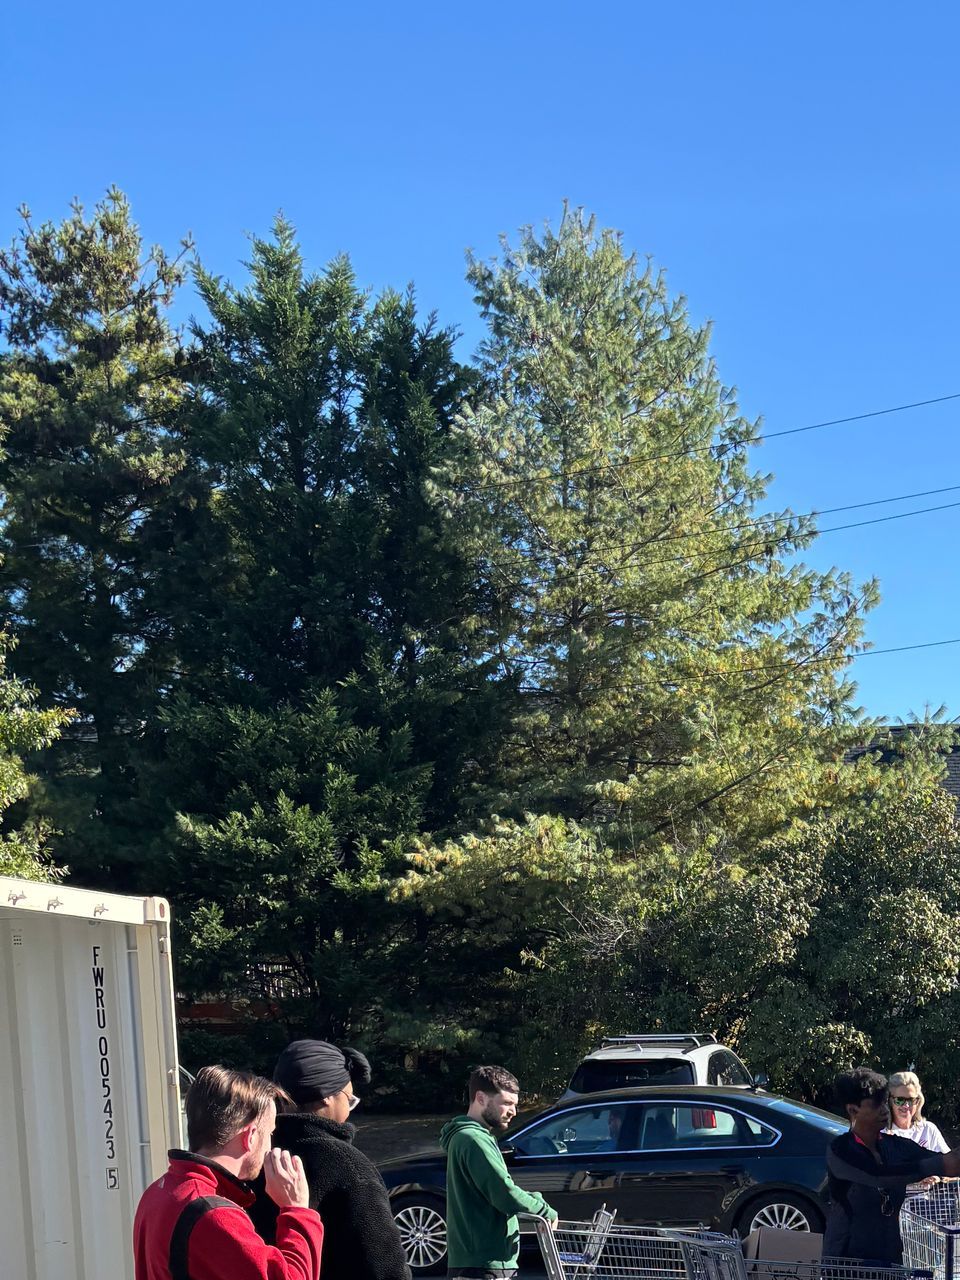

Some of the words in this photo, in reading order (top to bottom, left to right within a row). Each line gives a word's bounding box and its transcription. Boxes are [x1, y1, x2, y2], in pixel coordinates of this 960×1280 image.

[92, 946, 106, 1028] FWRU
[98, 1036, 115, 1159] 005423
[108, 1169, 117, 1188] 5
